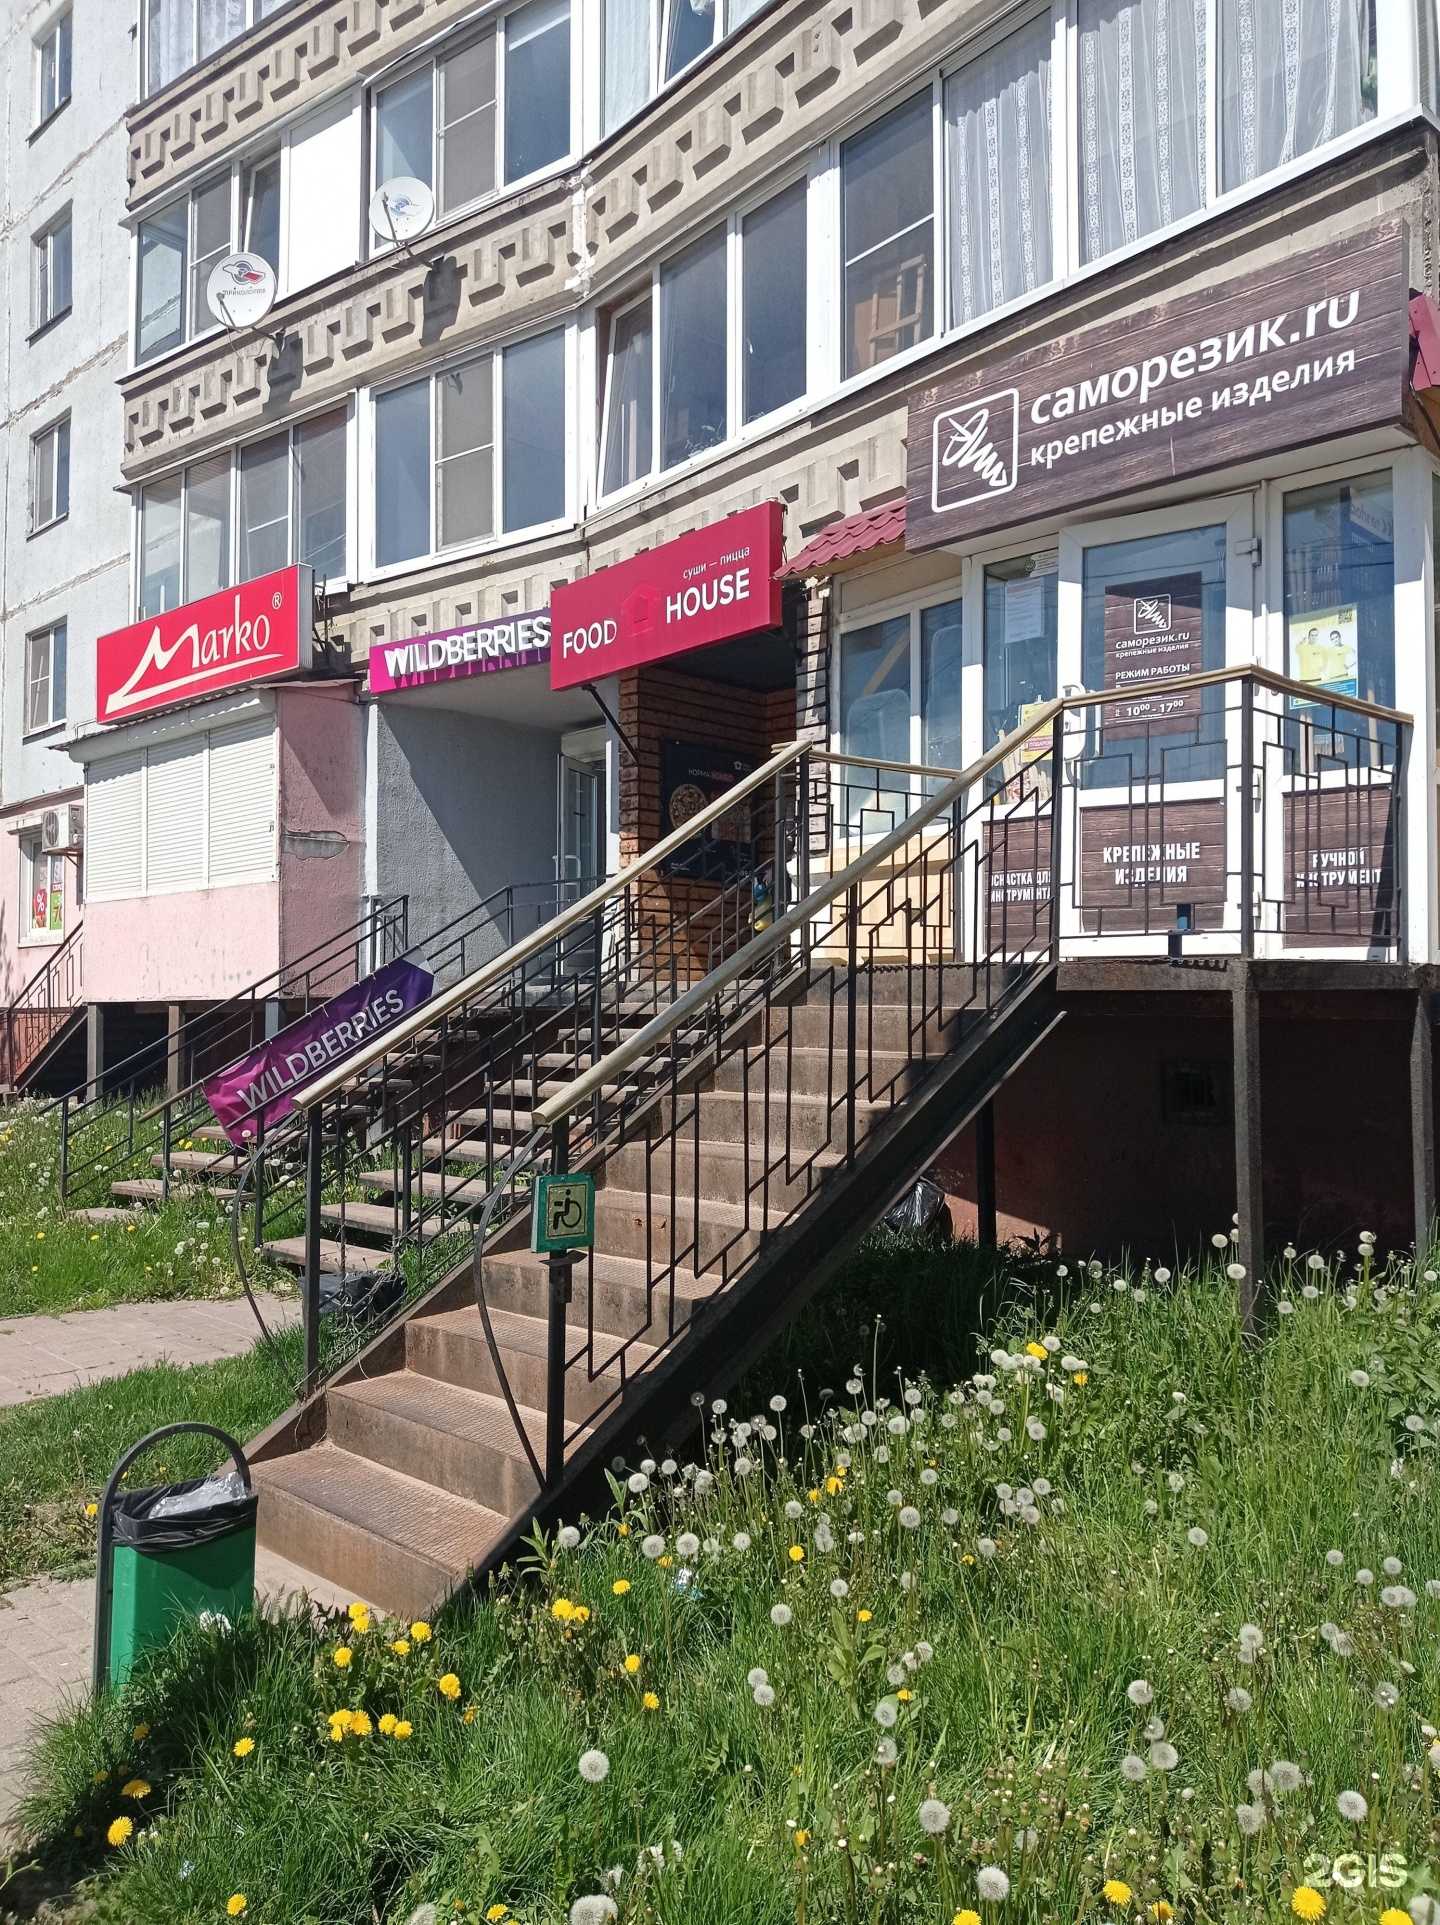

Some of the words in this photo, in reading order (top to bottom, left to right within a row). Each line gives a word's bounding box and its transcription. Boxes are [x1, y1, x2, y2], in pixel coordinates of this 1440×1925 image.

[1031, 291, 1360, 424] саморезик.ru
[1030, 395, 1202, 468] крепежные
[1211, 349, 1355, 412] изделия
[682, 562, 707, 580] суши
[720, 546, 750, 566] пицца
[666, 567, 750, 624] HOUSE
[106, 594, 284, 714] Marko
[384, 616, 551, 678] WILDBERRIES
[562, 619, 617, 659] FOOD
[1115, 632, 1190, 649] саморезик.ru
[1115, 646, 1157, 659] крепежные
[1158, 643, 1189, 654] изделия
[1115, 668, 1149, 680] РЕЖИМ
[1151, 663, 1190, 676] РАБОТЫ
[1103, 842, 1200, 863] КРЕПЕЖНЫЕ
[991, 871, 1033, 887] СНАСТКА
[1036, 870, 1051, 885] ДЛ
[236, 989, 404, 1112] WILDBERRIES
